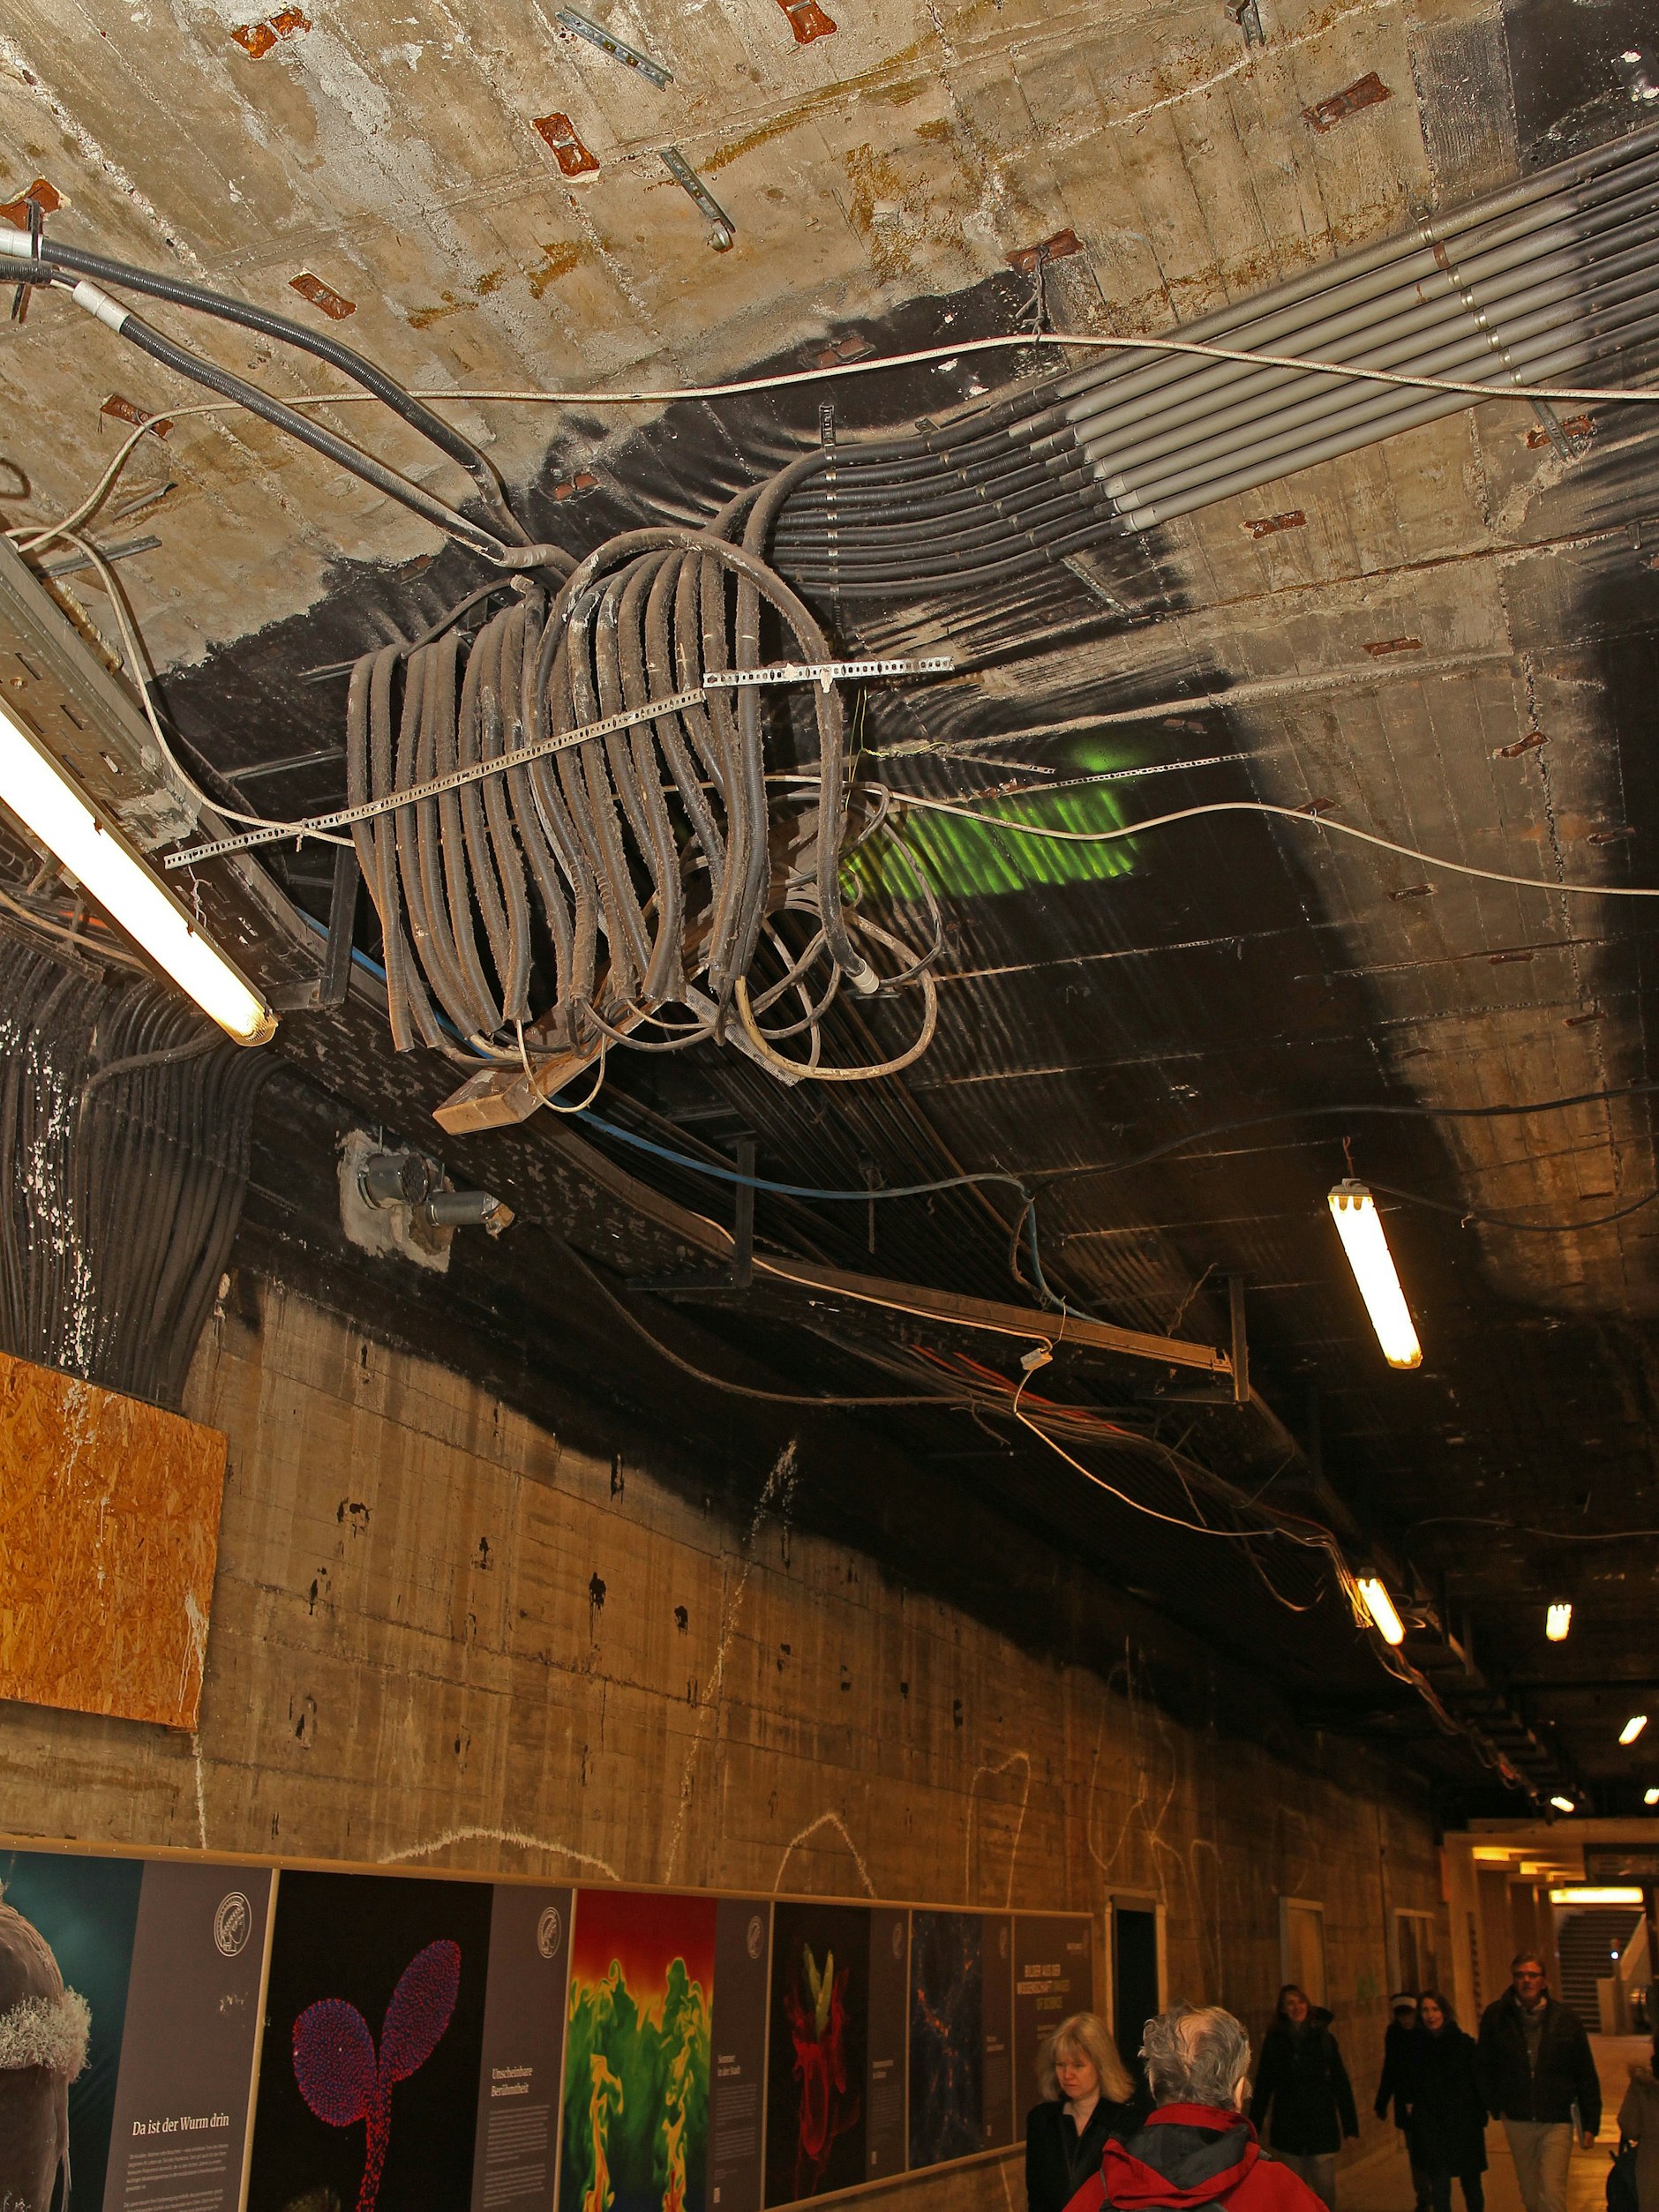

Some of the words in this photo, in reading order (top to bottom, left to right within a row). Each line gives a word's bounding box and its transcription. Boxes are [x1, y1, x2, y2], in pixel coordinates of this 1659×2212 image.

[492, 2066, 532, 2079] Unscheinbare
[491, 2083, 529, 2096] Berühmtheit
[132, 2121, 146, 2136] Da
[147, 2119, 161, 2134] ist
[161, 2118, 179, 2133] der
[180, 2116, 208, 2131] Wurm
[210, 2112, 229, 2127] drin
